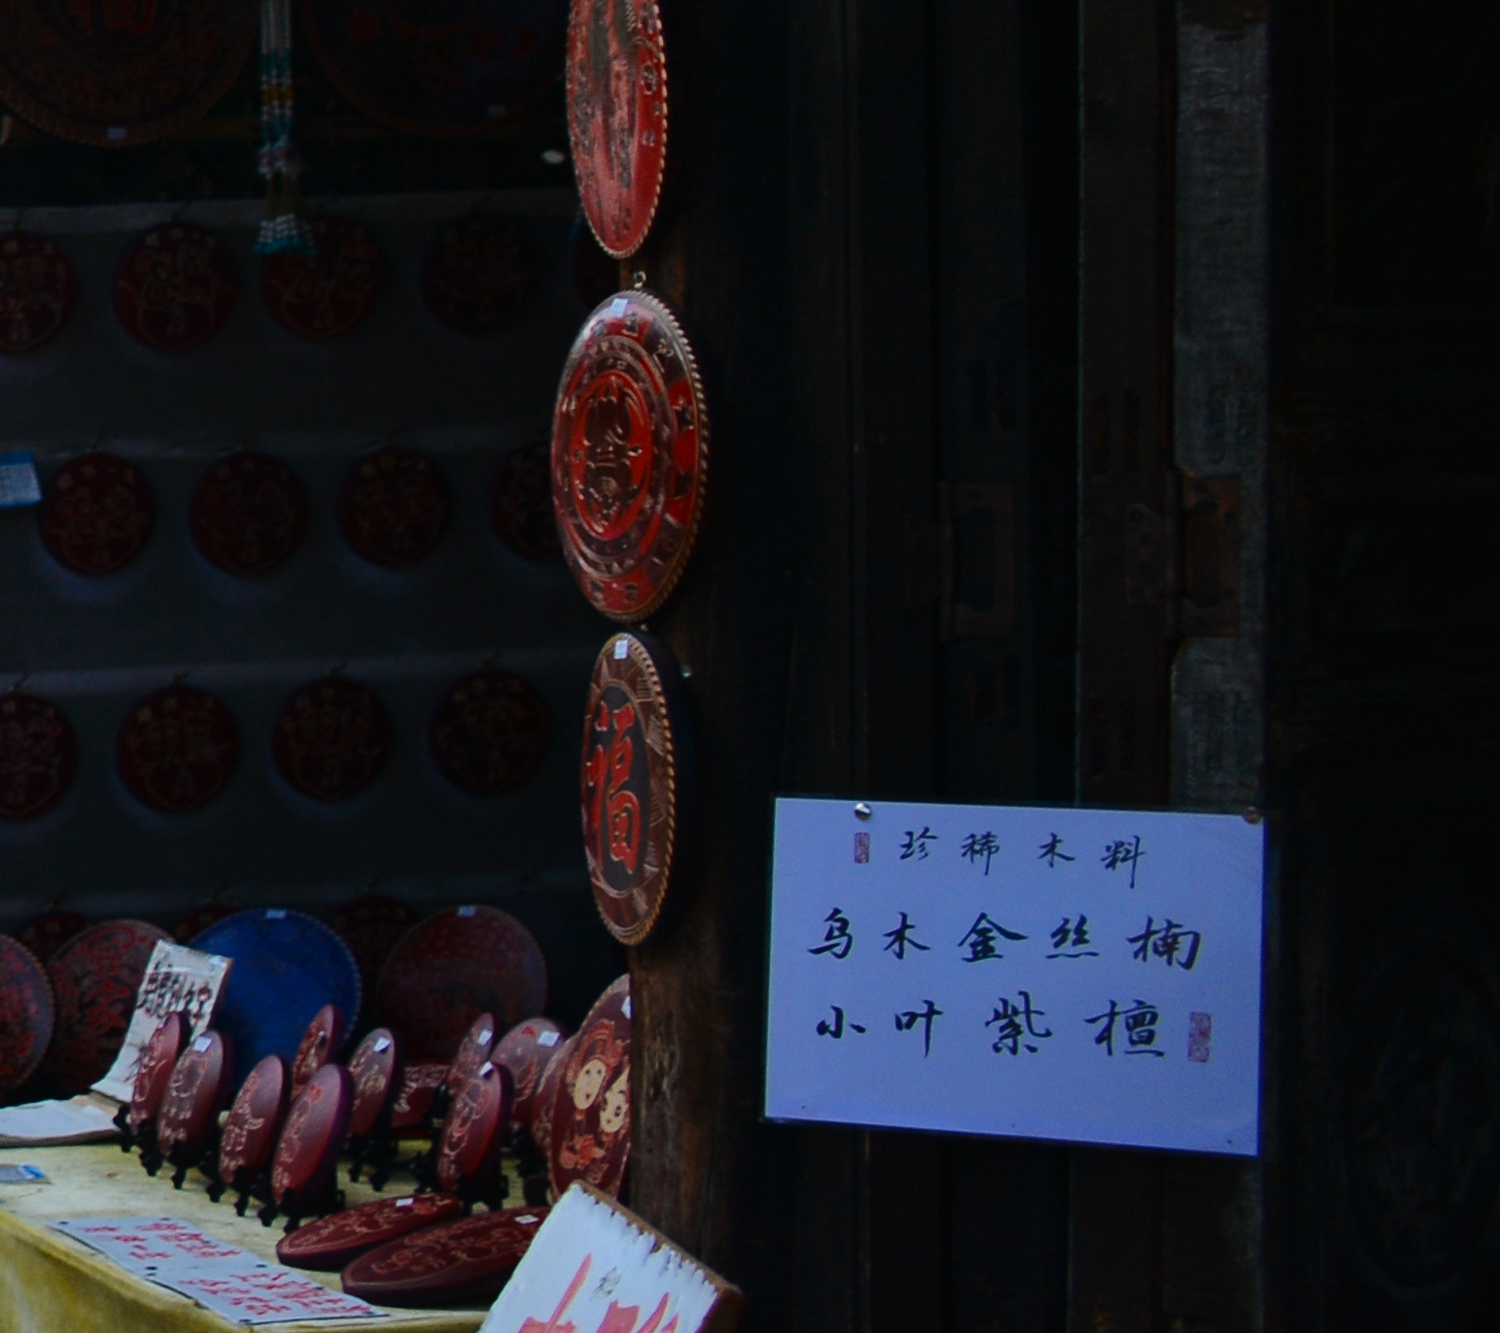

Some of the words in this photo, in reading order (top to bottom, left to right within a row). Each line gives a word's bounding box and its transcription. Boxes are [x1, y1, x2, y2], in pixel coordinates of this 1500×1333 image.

[900, 827, 1147, 888] 珍稀木料
[808, 907, 1202, 971] 乌木金丝楠
[815, 990, 1167, 1058] 小叶紫檀
